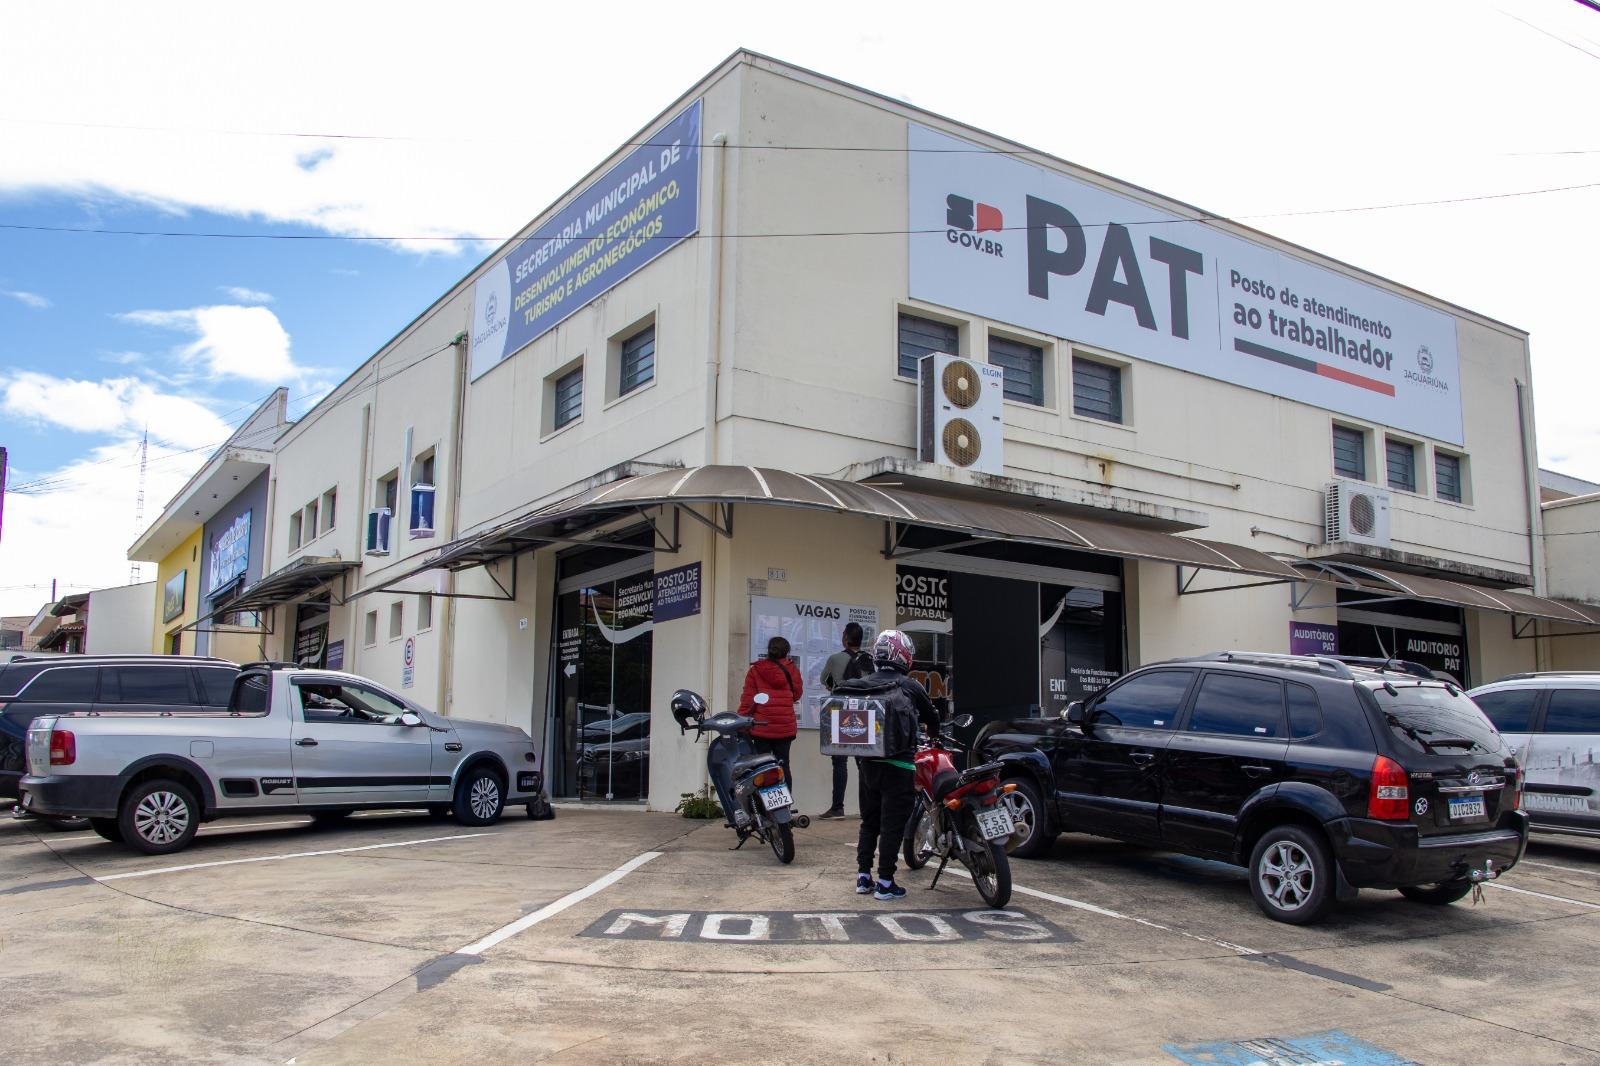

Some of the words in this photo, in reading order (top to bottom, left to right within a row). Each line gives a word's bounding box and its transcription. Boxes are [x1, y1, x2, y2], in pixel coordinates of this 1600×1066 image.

[515, 218, 583, 283] SECRETARIA
[585, 161, 656, 230] MUNICIPAL
[661, 139, 681, 173] DE
[515, 234, 604, 312] DESENVOLVIMENTO
[606, 180, 680, 244] ECONÔMICO,
[947, 229, 1004, 258] GOV.BR
[525, 286, 565, 325] TURISMO
[566, 278, 573, 297] E
[575, 215, 663, 291] AGRONEGÓCIOS
[1026, 194, 1204, 340] PAT
[1231, 269, 1275, 300] Posto
[1280, 287, 1298, 308] de
[1303, 298, 1392, 339] atendimento
[1233, 303, 1262, 329] ao
[1268, 309, 1393, 371] trabalhador
[982, 367, 1002, 378] ELGIN
[1404, 369, 1448, 391] JAGUARIÚNA
[657, 571, 685, 589] POSTO
[686, 568, 698, 582] DE
[769, 570, 786, 579] 810
[618, 582, 644, 596] Secretaria
[657, 581, 698, 599] ATENDIMENTO
[665, 591, 698, 605] TRABALHADOR
[795, 603, 840, 620] VAGAS
[849, 608, 867, 616] POSTO
[896, 606, 905, 615] O
[908, 607, 947, 620] TRABAL
[1294, 628, 1335, 641] AUDITÓRIO
[1322, 641, 1336, 652] PAT
[1444, 657, 1461, 671] PAT
[767, 788, 783, 800] CTN
[986, 823, 1010, 838] 6391
[603, 910, 1055, 942] MOTOS
